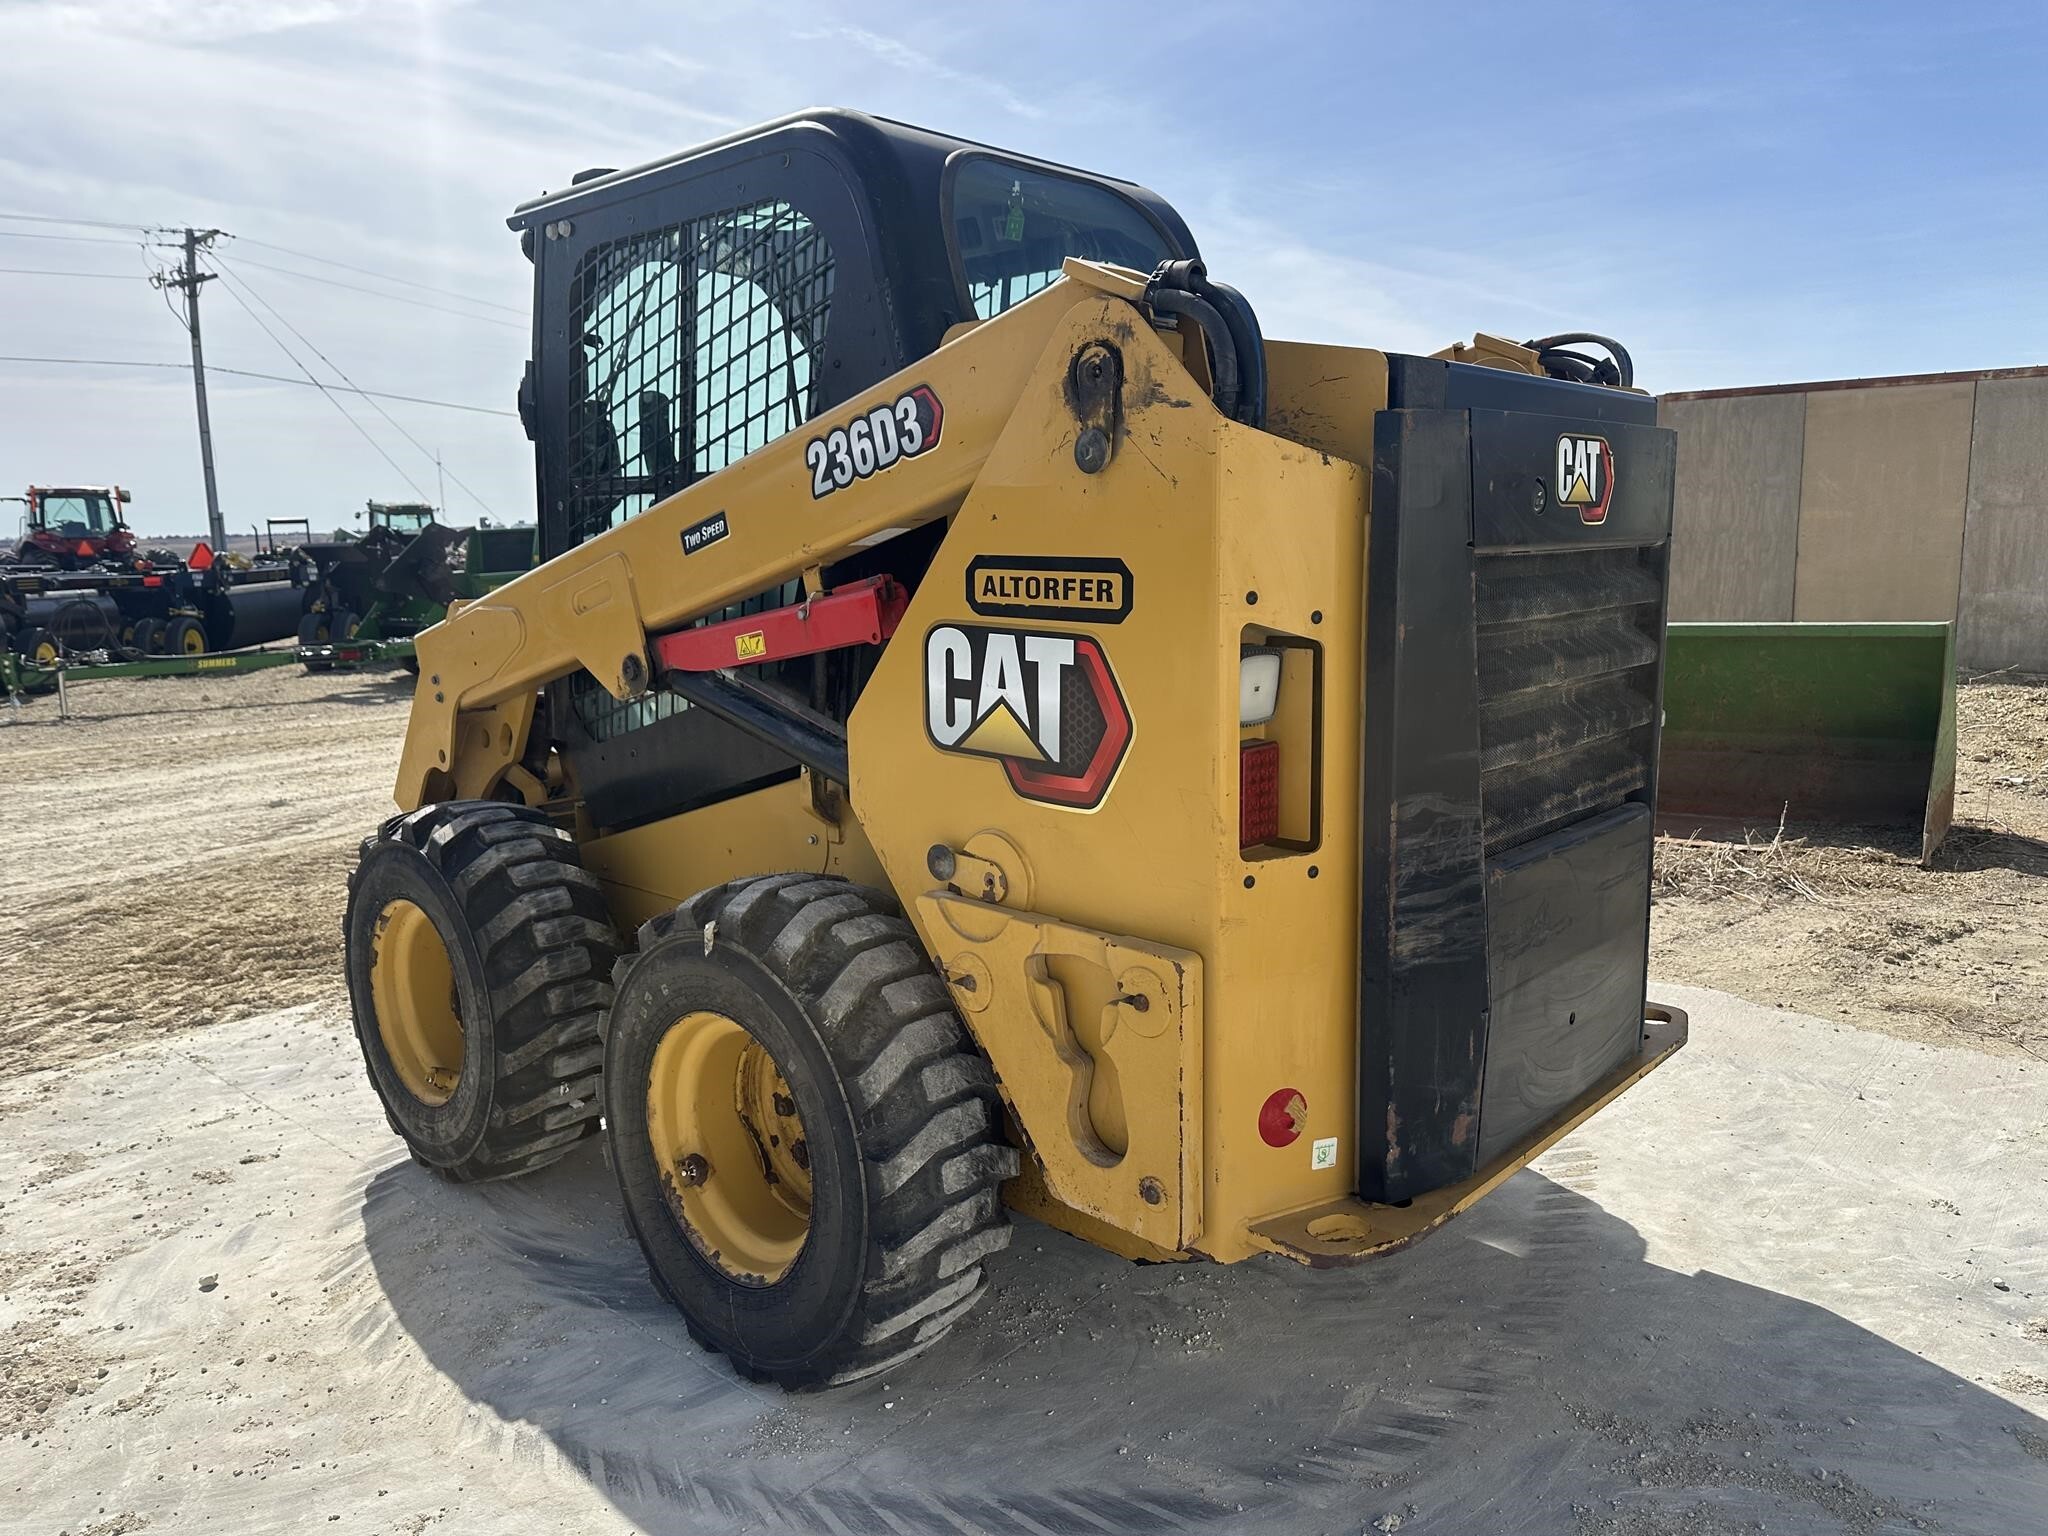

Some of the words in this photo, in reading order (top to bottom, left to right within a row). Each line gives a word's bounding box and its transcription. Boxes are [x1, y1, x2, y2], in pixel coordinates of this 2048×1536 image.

[807, 396, 922, 496] 236D3
[1558, 437, 1600, 502] CAT
[982, 575, 1114, 603] ALTORFER
[198, 657, 237, 669] SUMMERS
[927, 627, 1075, 763] CAT
